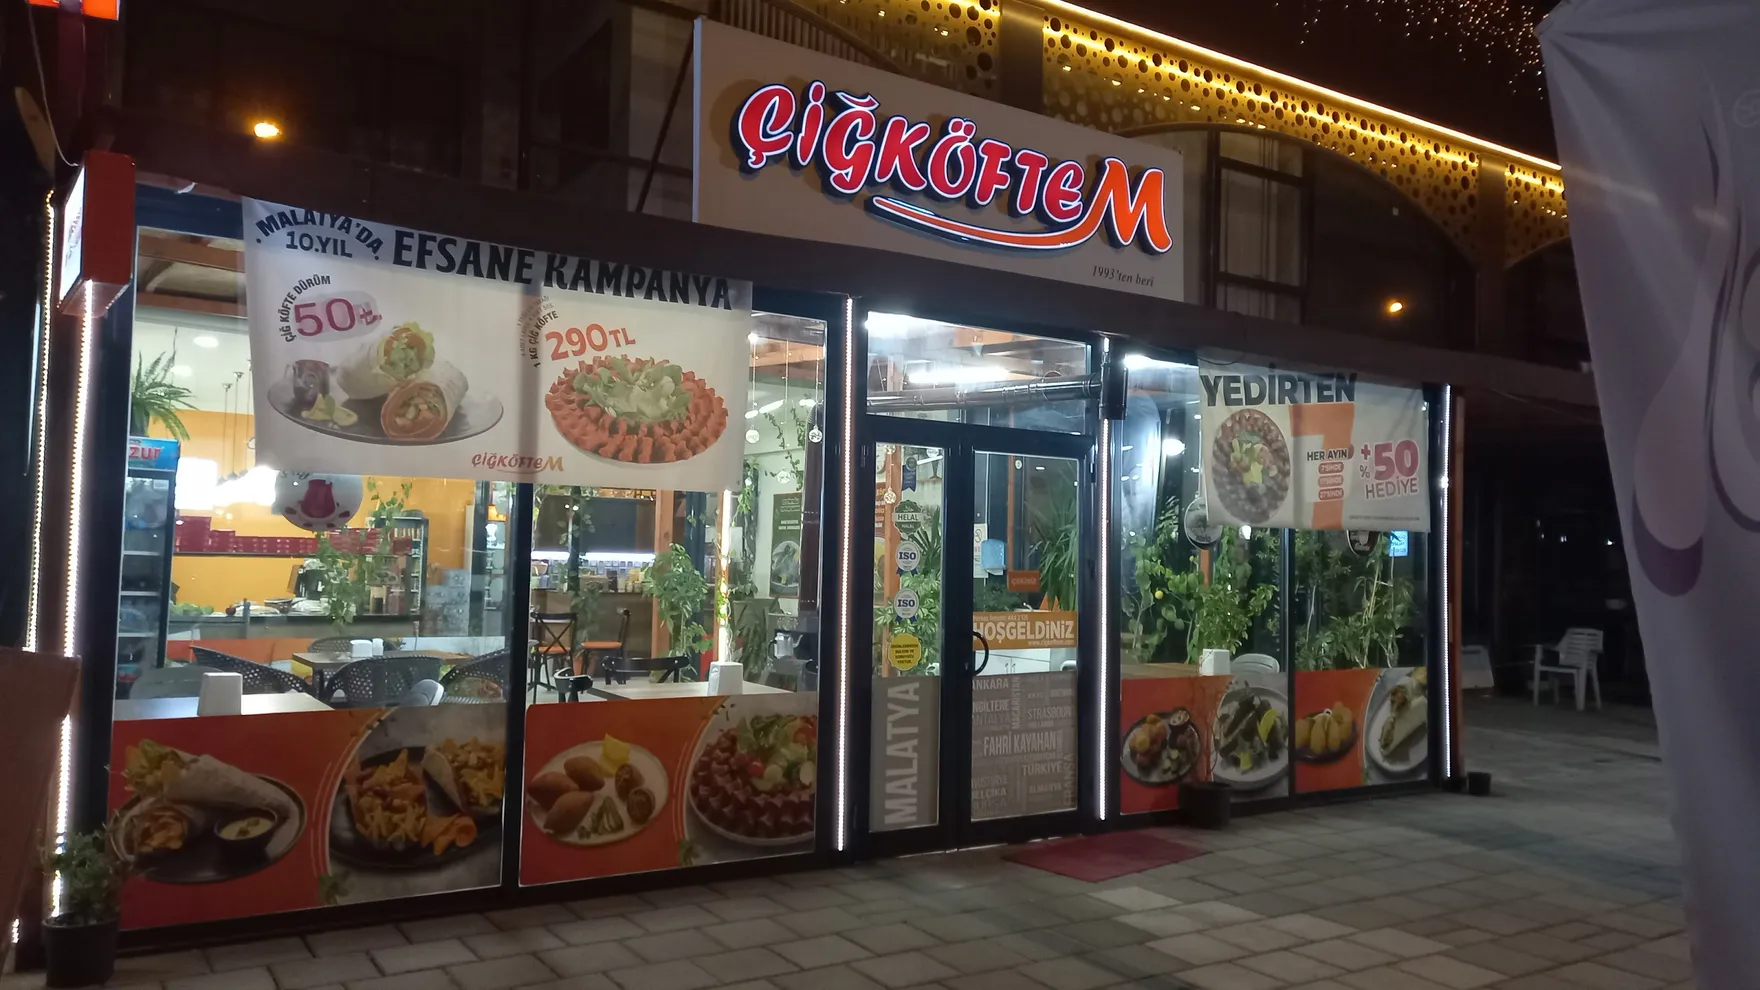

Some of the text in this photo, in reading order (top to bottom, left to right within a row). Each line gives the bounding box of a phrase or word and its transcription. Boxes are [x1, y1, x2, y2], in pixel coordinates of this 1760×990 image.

[393, 230, 732, 310] EFSANE KAMPANYA
[1135, 273, 1154, 287] beri
[278, 292, 296, 322] KÖFTE
[293, 274, 331, 295] DÜRÜM
[534, 310, 558, 331] KÖFTE
[1200, 362, 1357, 407] YEDİRTEN
[1307, 449, 1347, 461] HER AYIN
[1366, 476, 1418, 499] HEDİYE
[897, 513, 919, 521] HELAL
[898, 551, 917, 561] ISO
[897, 599, 916, 608] ISO
[884, 681, 919, 824] MALATYA
[984, 731, 1011, 757] FAHRİ
[1014, 731, 1056, 753] KAYAHAN
